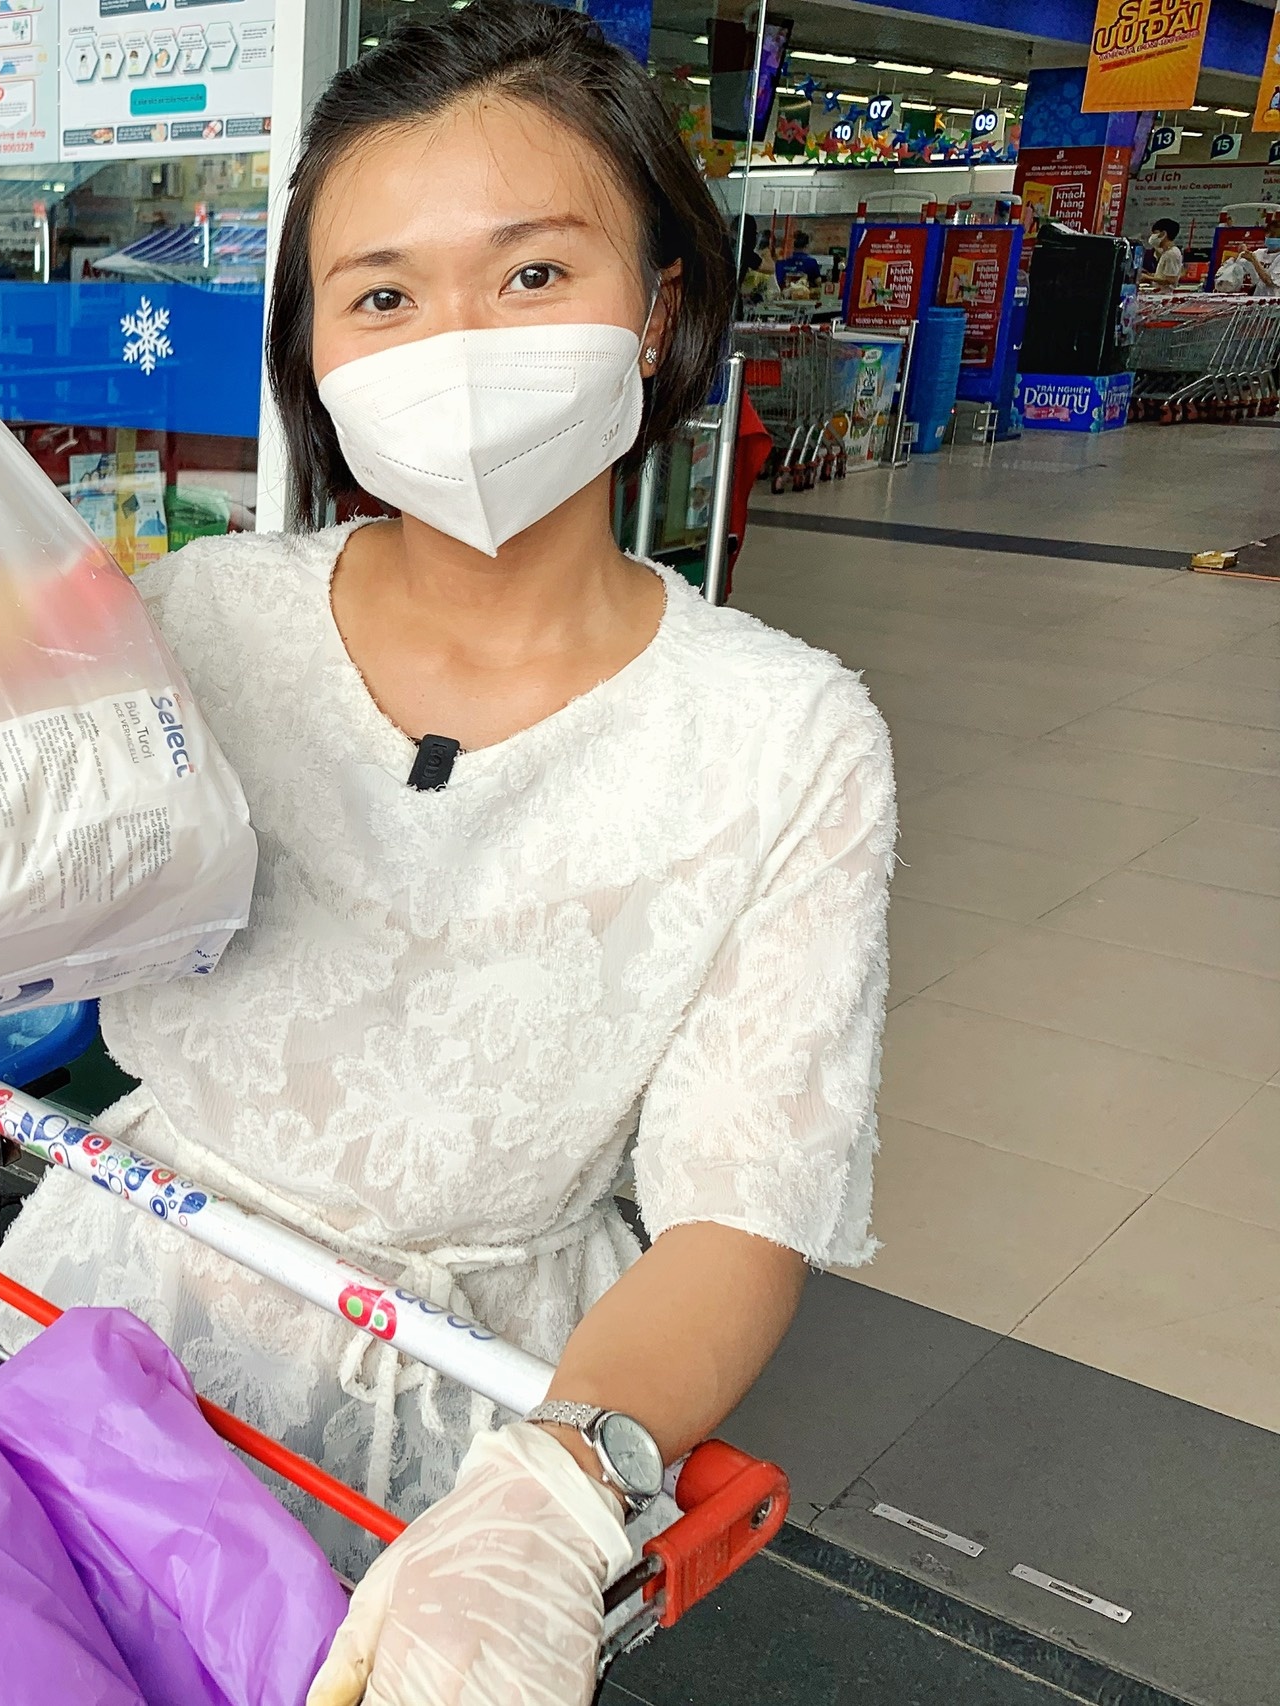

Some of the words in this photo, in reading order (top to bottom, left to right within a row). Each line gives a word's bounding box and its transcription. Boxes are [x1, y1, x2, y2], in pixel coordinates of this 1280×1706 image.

[870, 100, 892, 119] 07
[974, 115, 996, 131] 09
[834, 126, 851, 140] 10
[1156, 133, 1172, 145] 13
[1216, 139, 1230, 150] 15
[1161, 169, 1181, 181] ích
[1056, 191, 1086, 200] khách
[1060, 200, 1085, 210] hàng
[1056, 210, 1083, 219] thành
[890, 266, 913, 275] khách
[894, 275, 912, 283] hàng
[890, 283, 911, 291] thành
[1036, 384, 1055, 392] TRẢI
[1057, 386, 1091, 395] NGHIỆM
[1024, 387, 1090, 415] Downy
[113, 702, 124, 718] RICE
[120, 719, 140, 764] VERMICELLI
[124, 700, 141, 725] Bún
[136, 726, 155, 759] Tươi
[150, 695, 195, 778] Select
